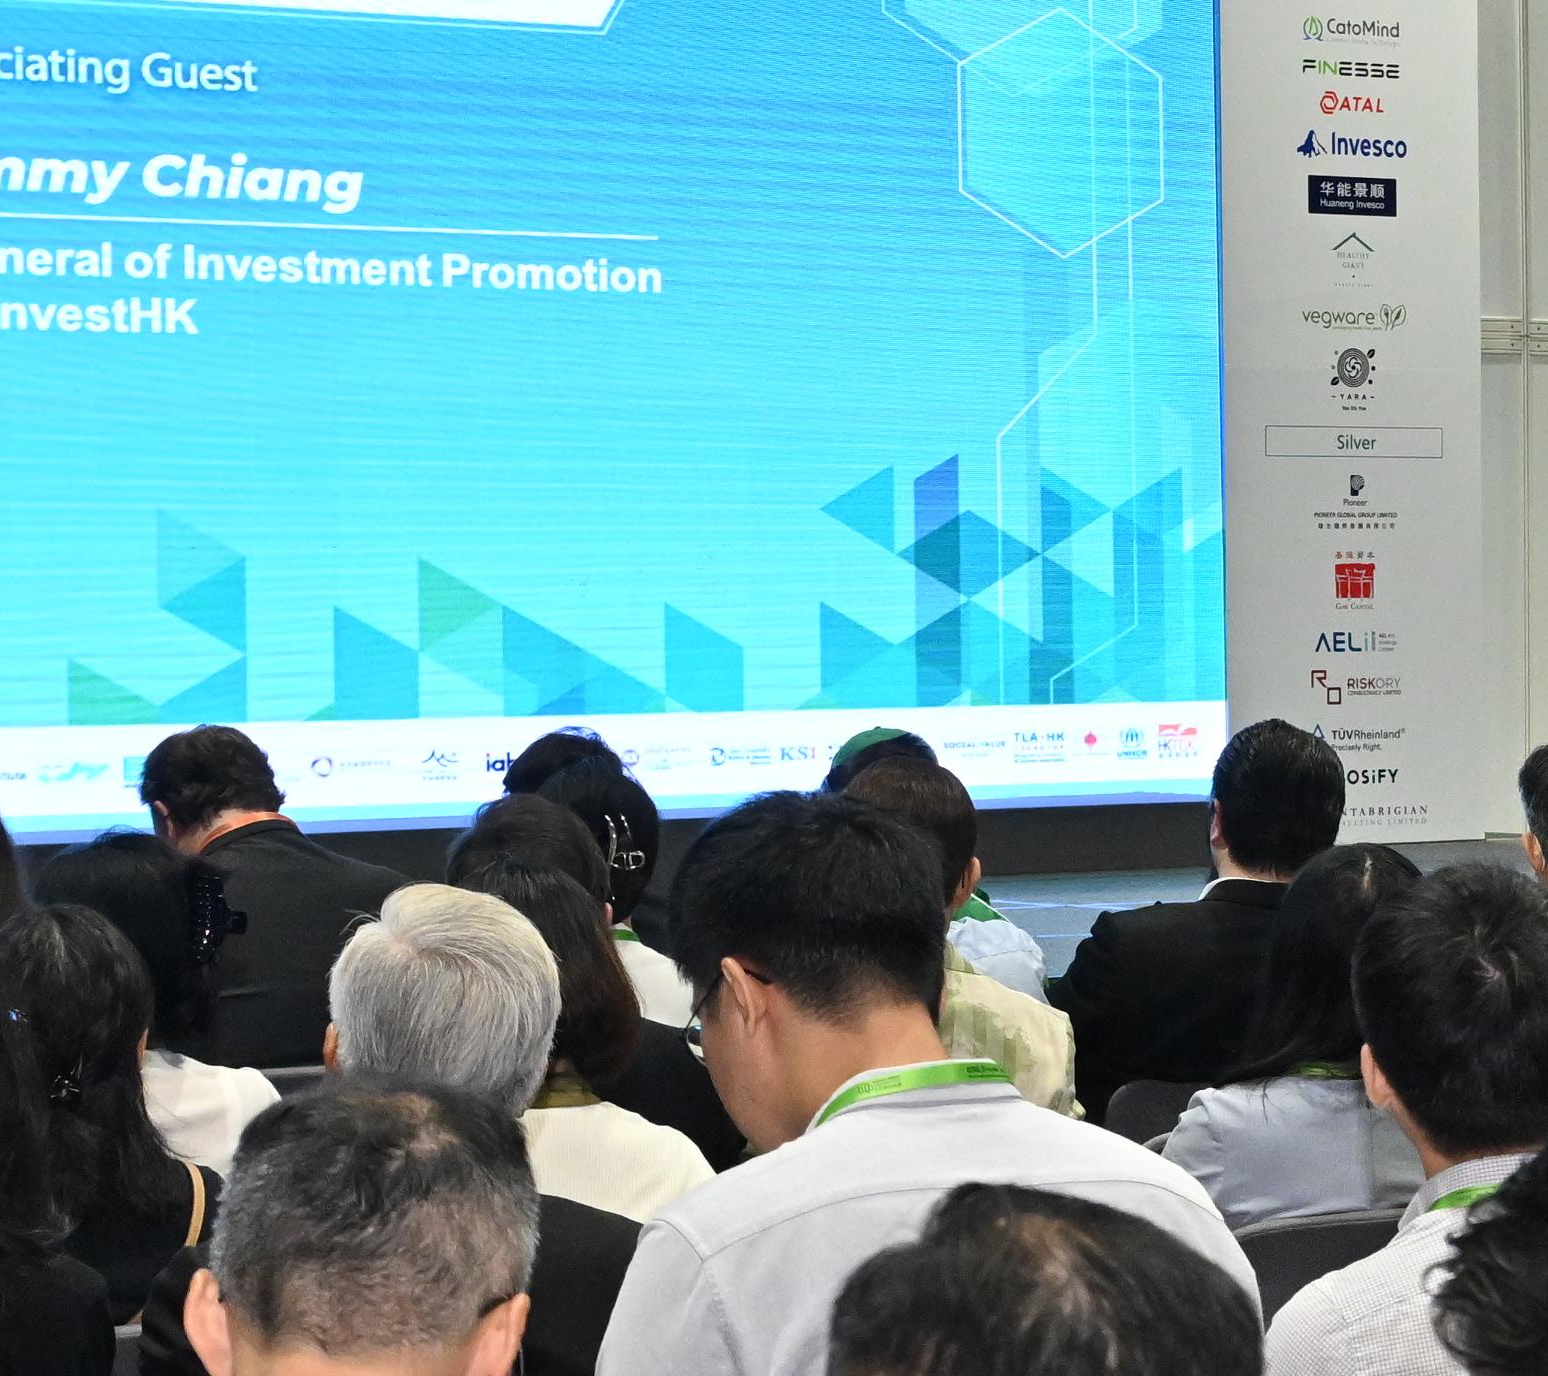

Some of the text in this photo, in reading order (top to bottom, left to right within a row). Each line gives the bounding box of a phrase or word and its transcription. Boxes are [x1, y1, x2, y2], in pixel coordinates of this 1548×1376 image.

[1326, 18, 1400, 39] CatoMind
[140, 51, 259, 92] Guest
[1302, 59, 1400, 80] FINESSE
[1331, 131, 1408, 159] Invesco
[141, 152, 363, 214] Chiang
[1319, 181, 1386, 199] 华能景顺
[1319, 198, 1386, 211] Huaneng Invesco
[124, 243, 173, 280] of
[183, 243, 434, 288] Investment
[441, 252, 663, 295] Promotion
[1302, 310, 1376, 329] vegware
[1337, 434, 1377, 451] Silver
[1343, 498, 1369, 507] Pioneer
[1347, 677, 1401, 690] RISKORY
